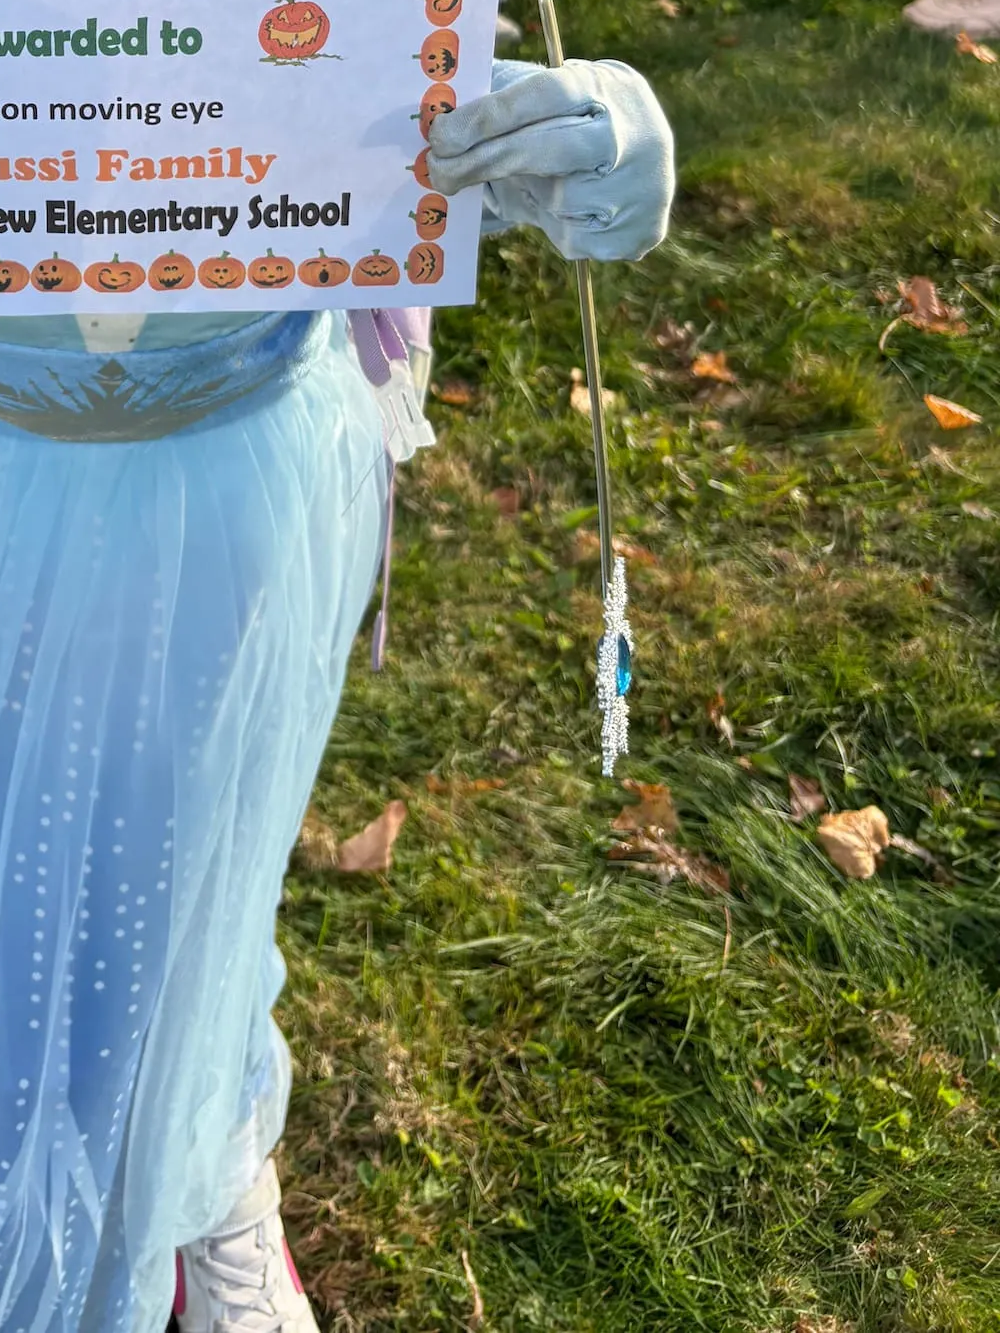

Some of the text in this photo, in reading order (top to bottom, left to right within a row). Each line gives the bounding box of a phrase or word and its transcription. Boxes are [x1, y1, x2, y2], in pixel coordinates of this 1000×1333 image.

[160, 20, 202, 55] to
[50, 97, 161, 125] moving
[172, 102, 223, 124] eye
[95, 147, 276, 184] Family
[46, 200, 238, 237] Elementary
[248, 193, 351, 229] School
